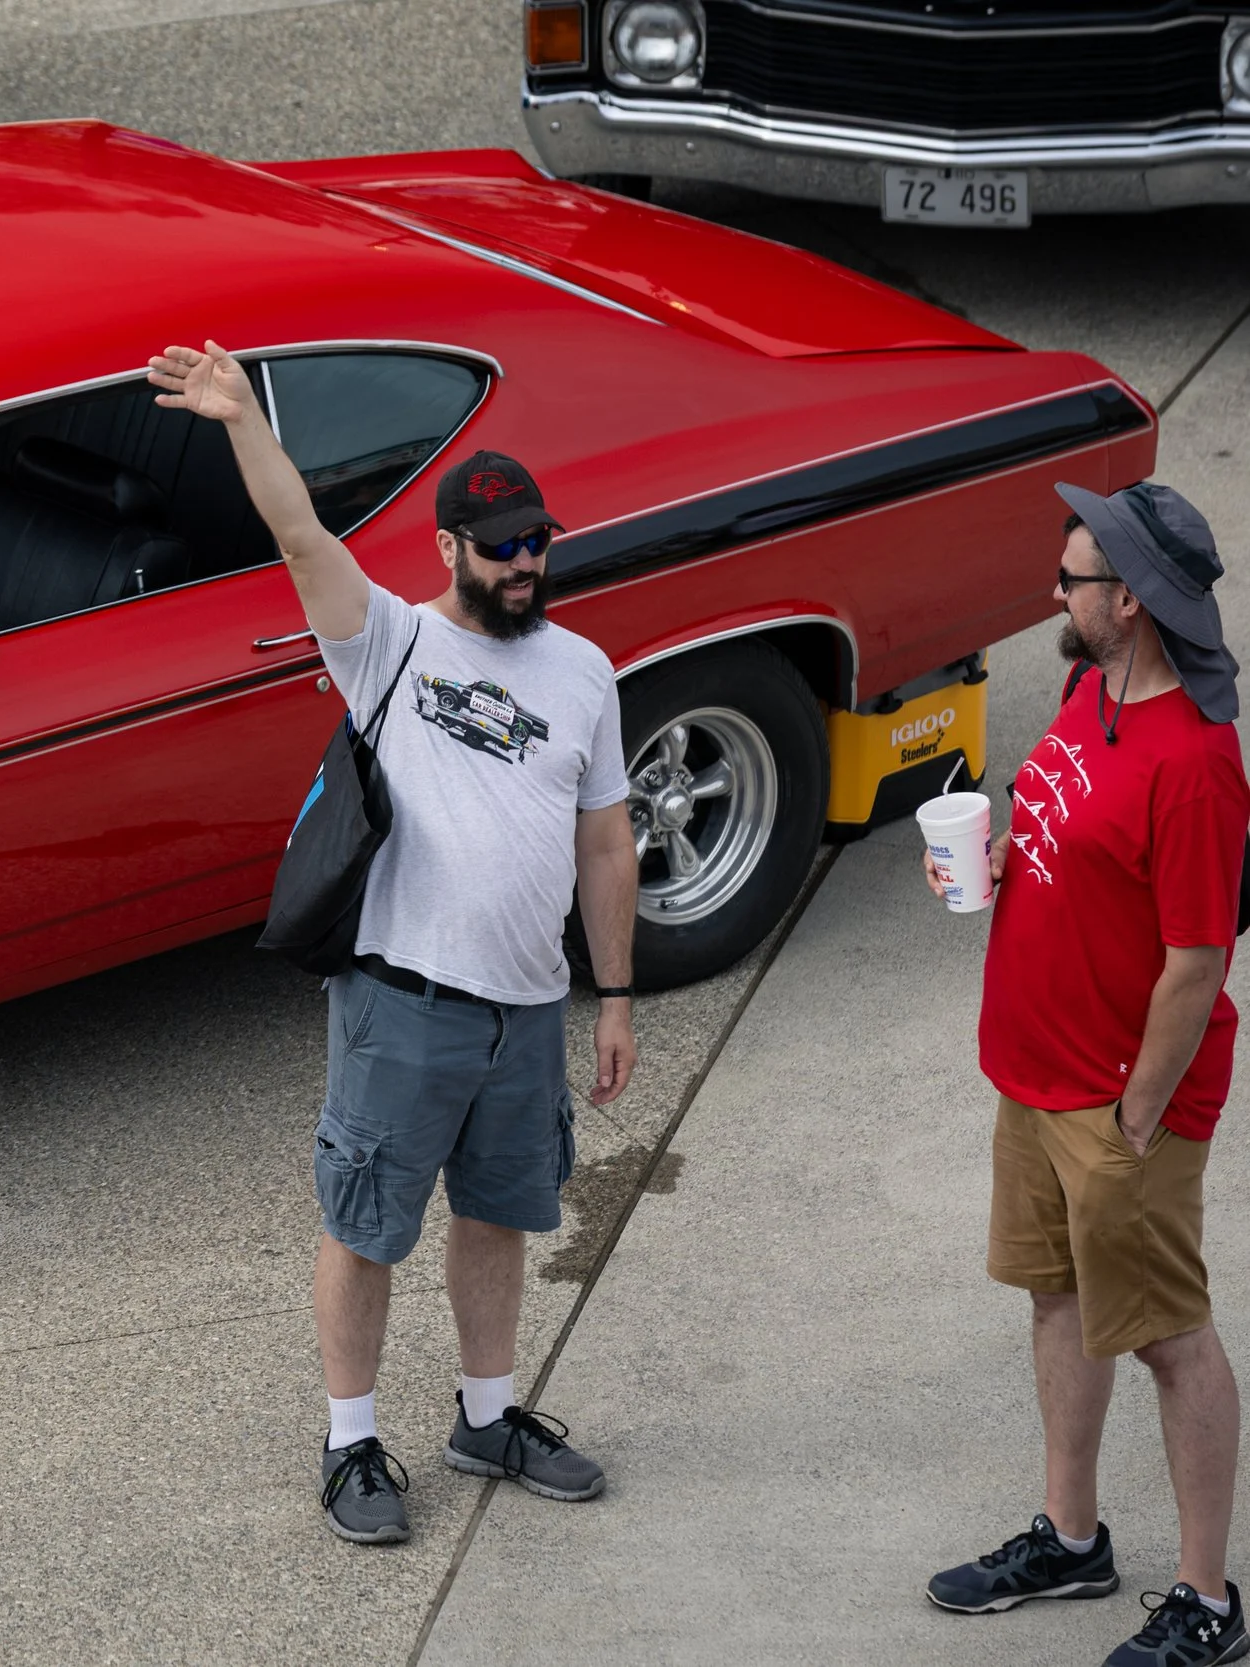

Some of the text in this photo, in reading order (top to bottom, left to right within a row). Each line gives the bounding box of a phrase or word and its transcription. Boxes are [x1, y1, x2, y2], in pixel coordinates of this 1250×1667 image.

[899, 180, 1016, 214] 72 496
[891, 708, 955, 747] IGLOO
[901, 742, 938, 764] Steelers
